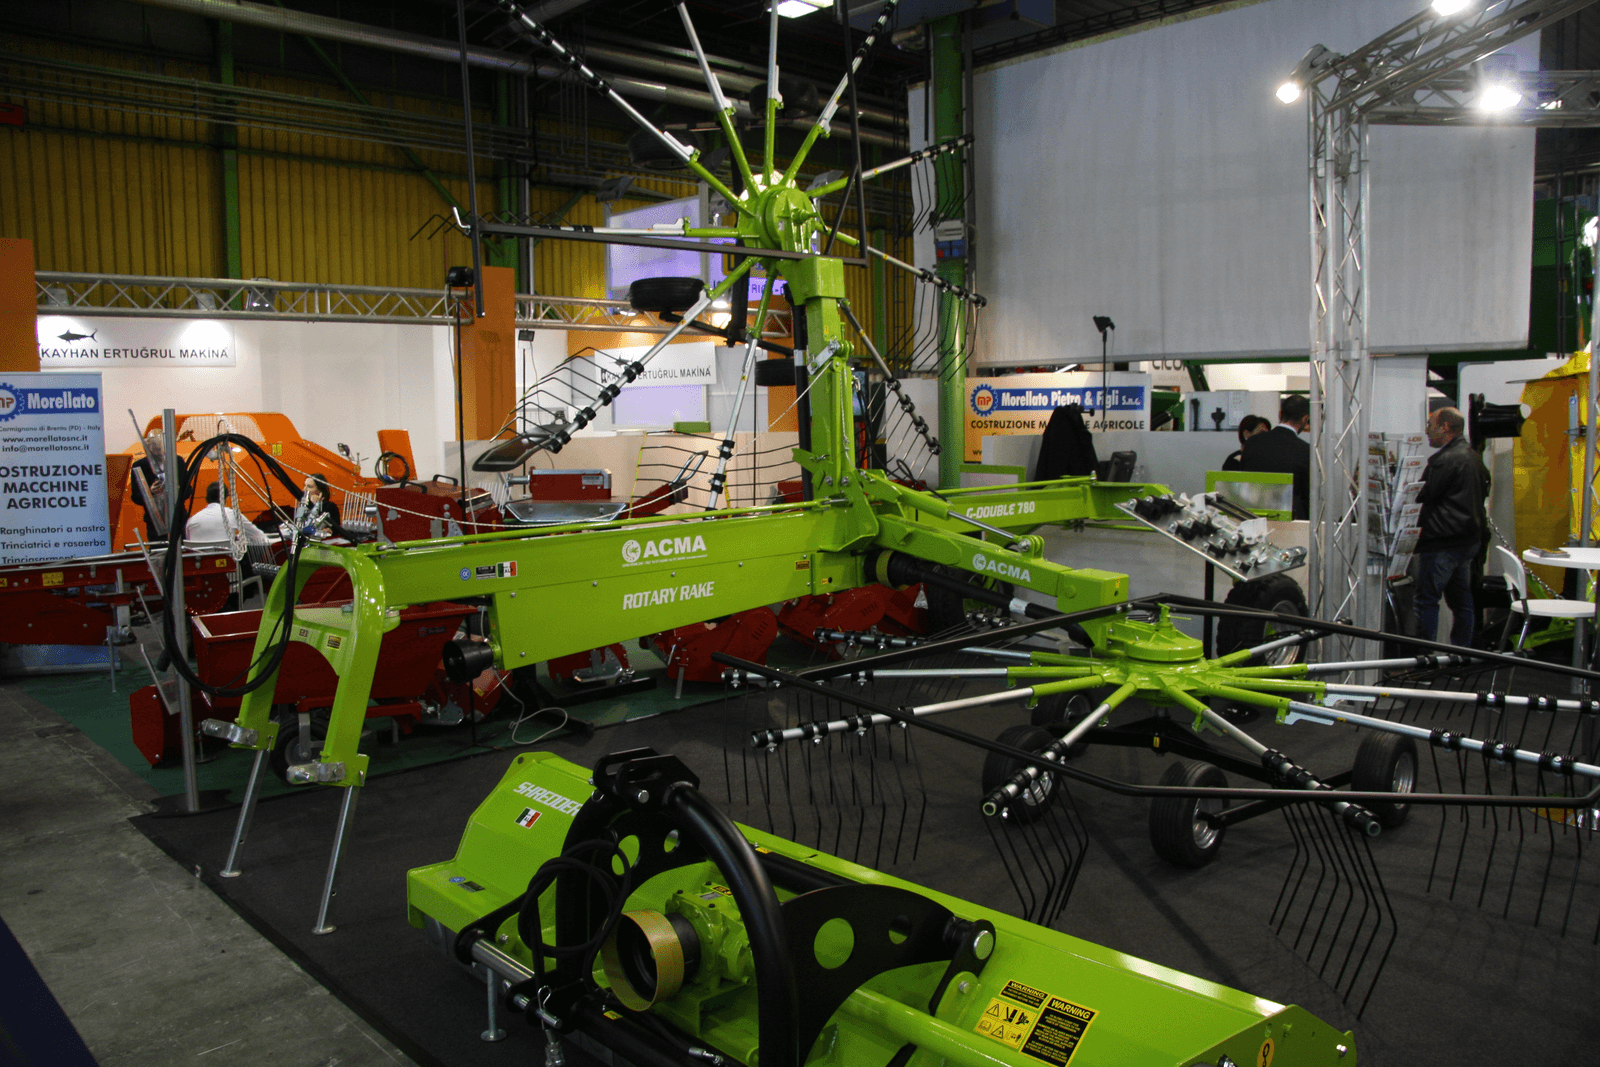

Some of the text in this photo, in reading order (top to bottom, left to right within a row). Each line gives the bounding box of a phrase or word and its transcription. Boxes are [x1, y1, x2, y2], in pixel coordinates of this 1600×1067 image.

[41, 346, 229, 359] KAYHAN ERTUĞRUL MAKİNA
[637, 368, 678, 380] ERTUĞRUL
[680, 366, 711, 377] MAKİNA
[27, 391, 96, 409] Morellato
[1001, 390, 1049, 407] Morellato
[1051, 389, 1081, 407] Pietro
[1084, 391, 1093, 406] &
[970, 419, 1036, 430] COSTRUZIONE
[1093, 420, 1145, 430] AGRICOLE
[2, 435, 88, 443] www.morellatosnc.it
[2, 445, 90, 453] info@morellatosnc.it
[3, 480, 89, 494] MACCHINE
[7, 496, 87, 510] AGRICOLE
[966, 500, 1036, 519] G-DOUBLE 780
[0, 525, 64, 537] Ranghinatori
[75, 524, 106, 533] nastro
[1, 540, 52, 550] Trinciatrici
[63, 538, 106, 548] rasaerba
[643, 534, 707, 559] ACMA
[986, 559, 1032, 583] ACMA
[622, 580, 715, 611] ROTARY RAKE
[512, 781, 584, 817] SHREDDER
[1011, 982, 1045, 999] WARNING
[1051, 999, 1091, 1020] WARNING
